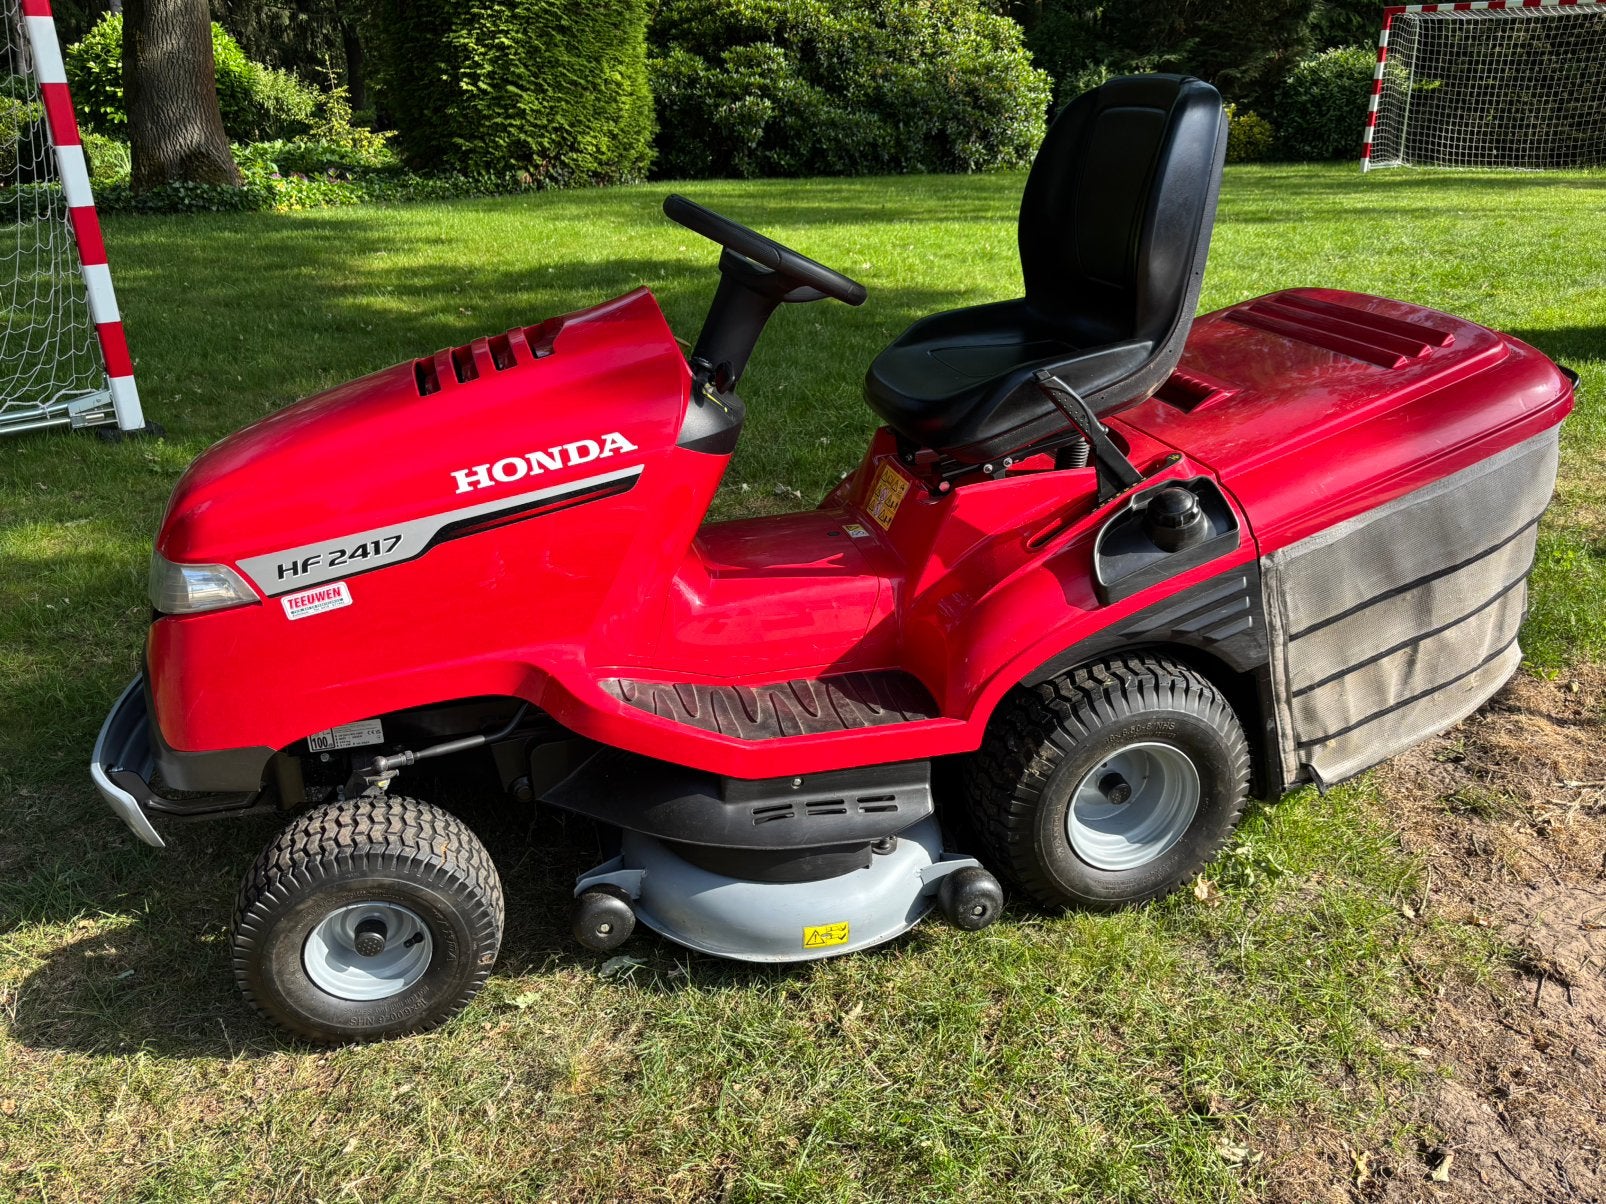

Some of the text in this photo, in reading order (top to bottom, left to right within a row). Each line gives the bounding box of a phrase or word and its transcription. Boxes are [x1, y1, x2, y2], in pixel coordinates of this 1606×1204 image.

[450, 431, 638, 494] HONDA
[277, 534, 403, 581] HF 2417
[287, 587, 341, 609] TEEUWEN
[311, 736, 328, 749] 100
[349, 1015, 375, 1026] NHS
